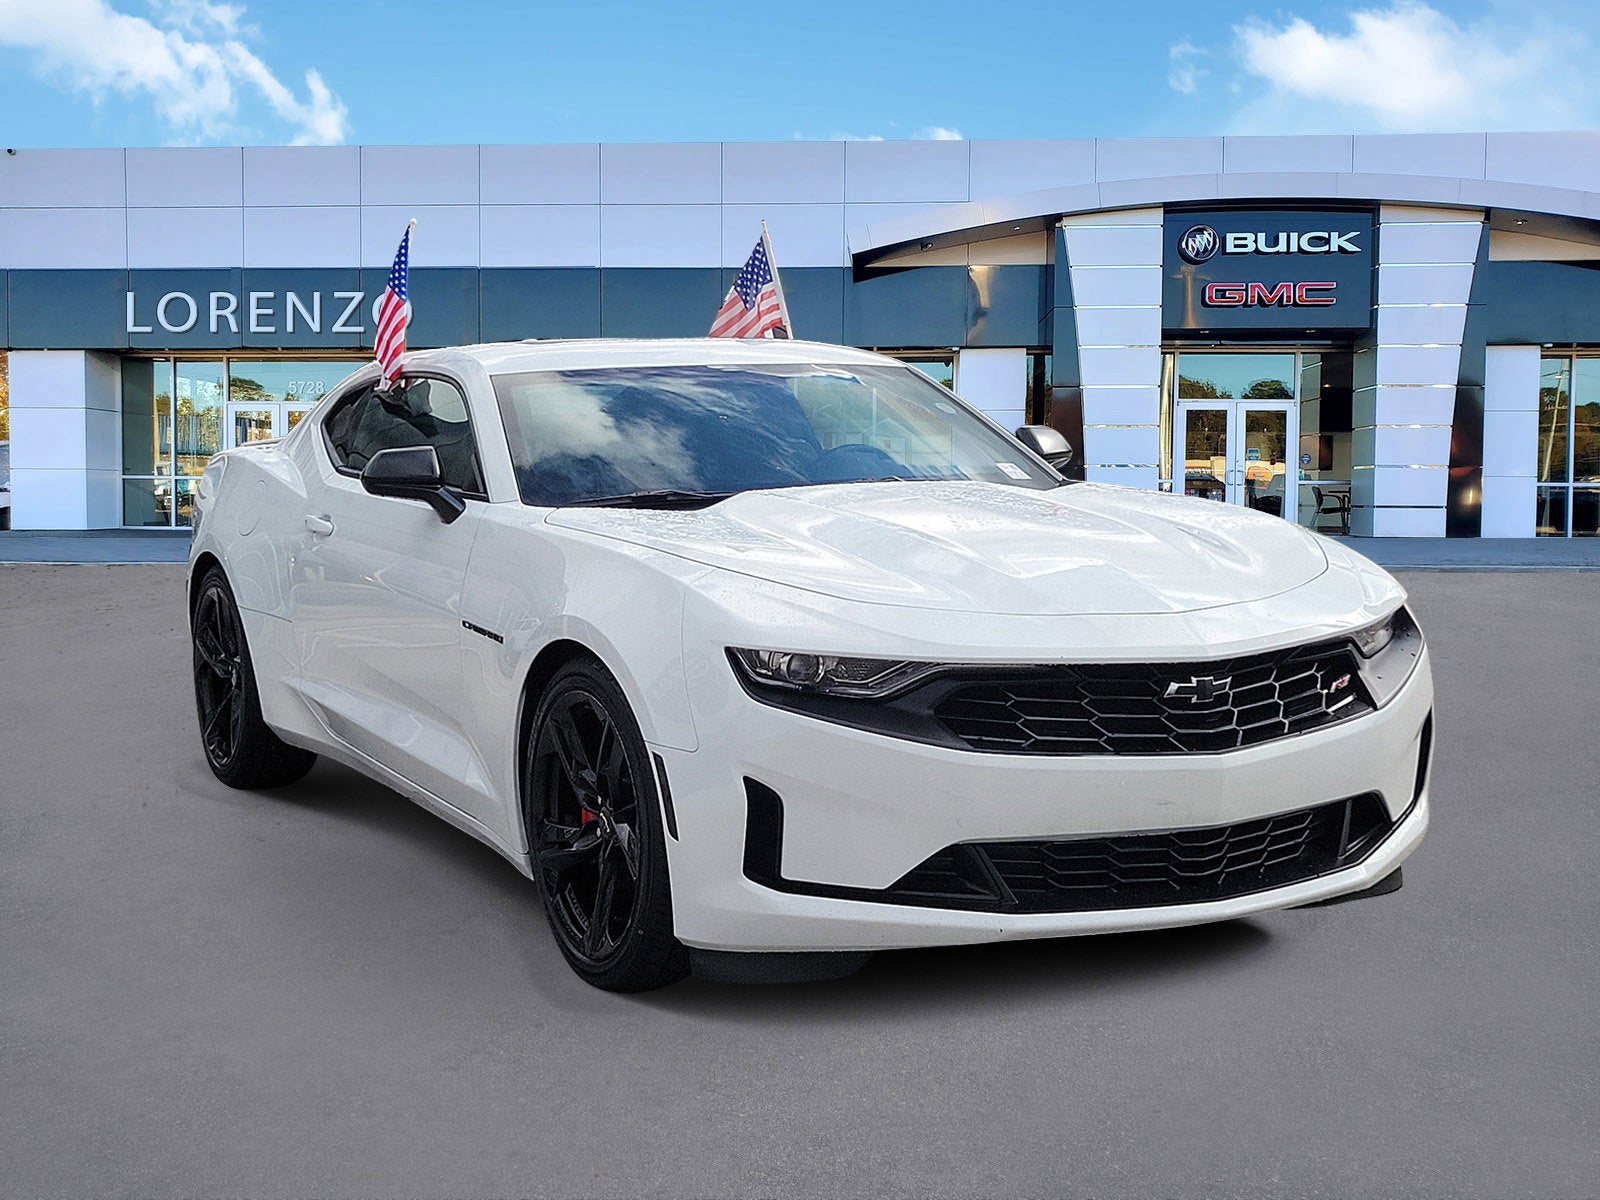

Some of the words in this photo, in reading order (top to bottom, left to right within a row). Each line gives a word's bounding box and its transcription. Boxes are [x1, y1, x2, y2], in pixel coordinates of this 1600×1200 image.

[1225, 231, 1362, 253] BUICK
[1205, 282, 1337, 305] GMC
[288, 380, 325, 394] 5728
